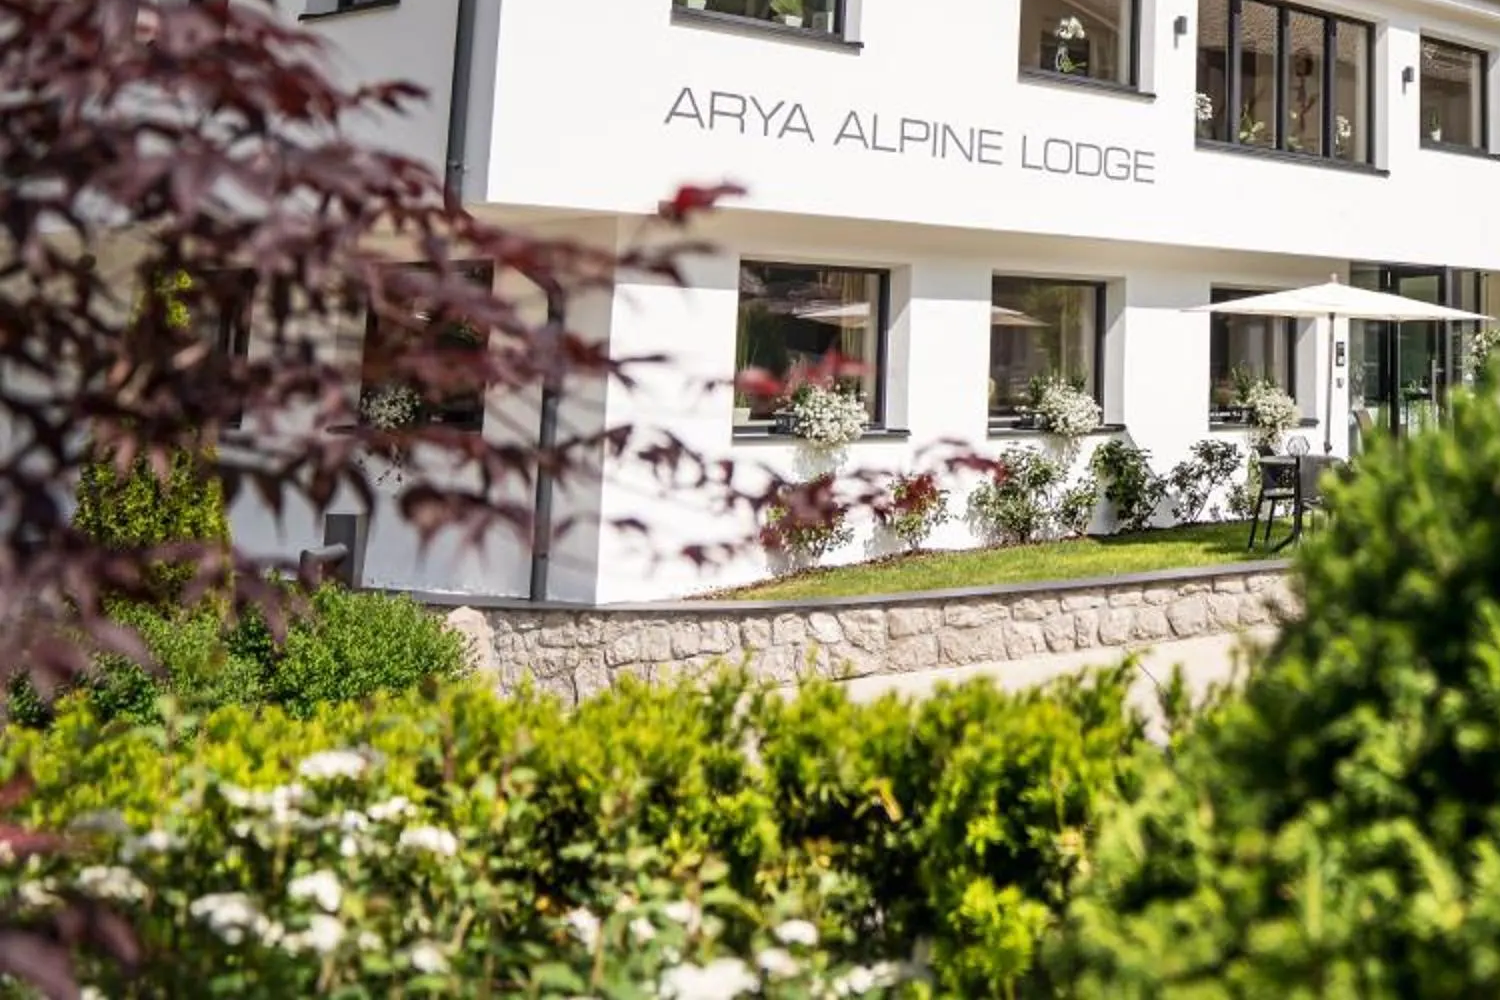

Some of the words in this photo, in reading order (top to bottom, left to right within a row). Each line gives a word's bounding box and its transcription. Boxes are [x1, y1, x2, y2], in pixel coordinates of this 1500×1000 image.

[664, 87, 814, 142] ARYA
[833, 110, 1004, 165] ALPINE
[1021, 135, 1156, 184] LODGE
